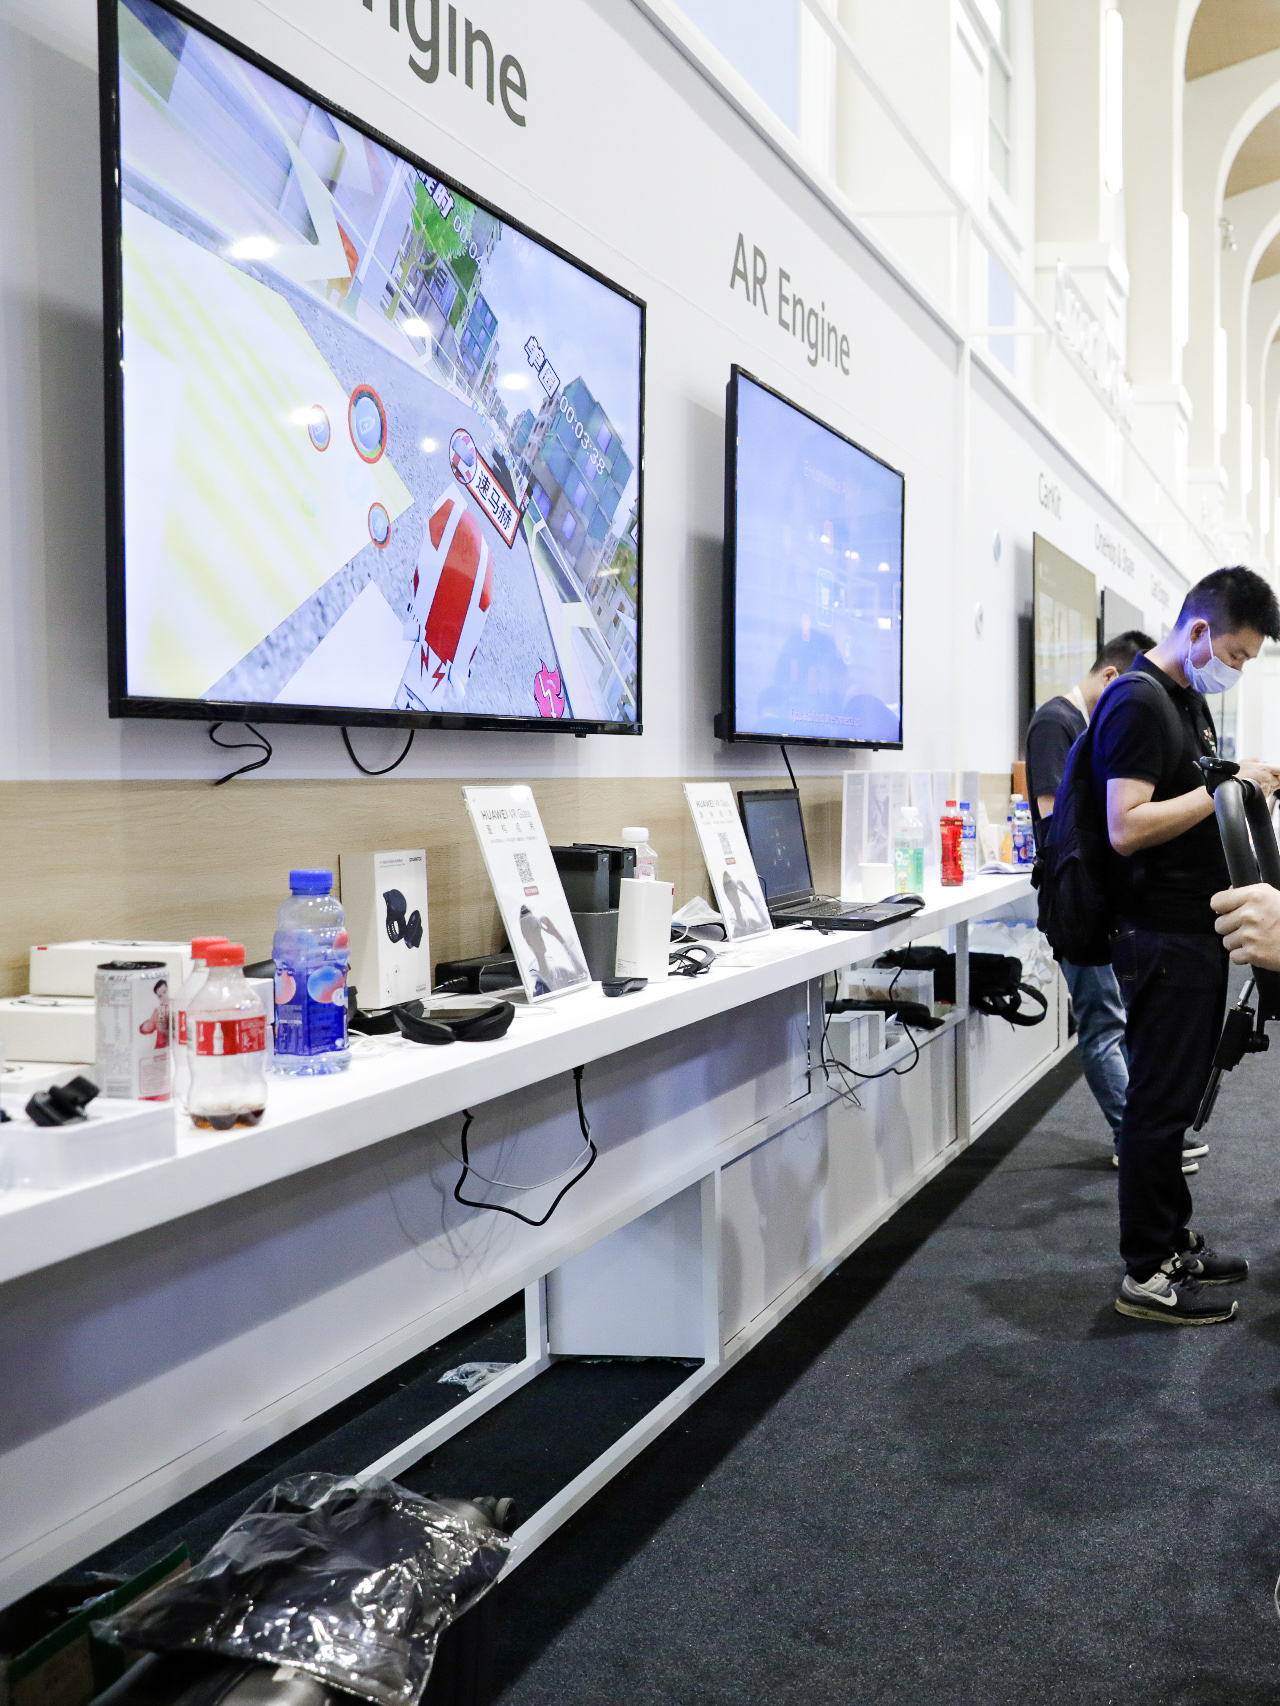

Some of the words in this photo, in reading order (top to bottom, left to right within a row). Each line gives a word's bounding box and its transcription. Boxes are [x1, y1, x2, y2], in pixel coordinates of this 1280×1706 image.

[730, 232, 768, 316] AR
[778, 267, 850, 376] Engine
[560, 396, 606, 475] 00:03:38
[476, 472, 513, 530] 速马赫
[481, 809, 508, 820] HUAWEI
